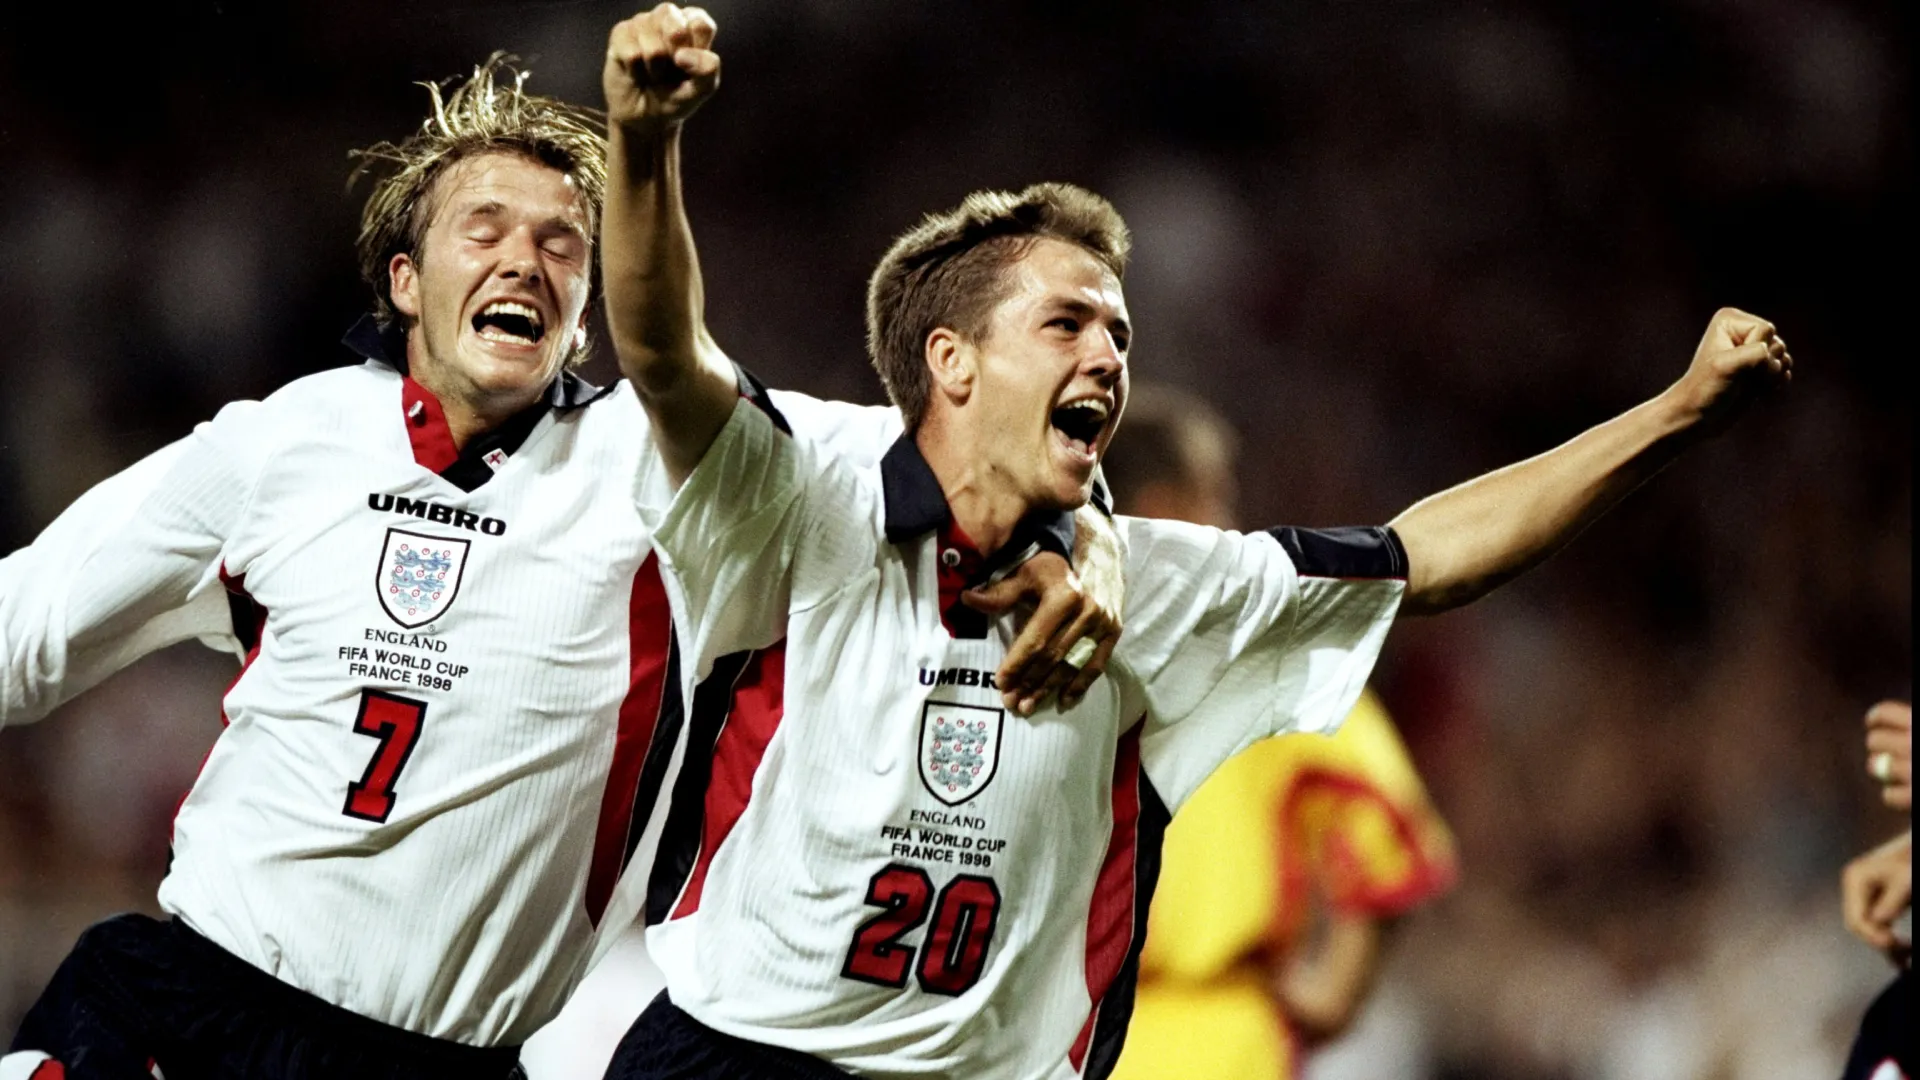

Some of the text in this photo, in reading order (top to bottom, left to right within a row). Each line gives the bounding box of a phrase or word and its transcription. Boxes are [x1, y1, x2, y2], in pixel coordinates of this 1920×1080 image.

[368, 493, 507, 536] UMBRO
[364, 628, 448, 653] ENGLAND
[338, 646, 469, 679] FIFA WORLD CUP
[349, 663, 453, 691] FRANCE 1998
[918, 667, 1001, 690] UMBR
[342, 687, 429, 824] 7
[909, 809, 986, 830] ENGLAND
[880, 825, 1006, 853] FIFA WORLD CUP
[891, 843, 992, 867] FRANCE 1998
[840, 862, 1002, 998] 20
